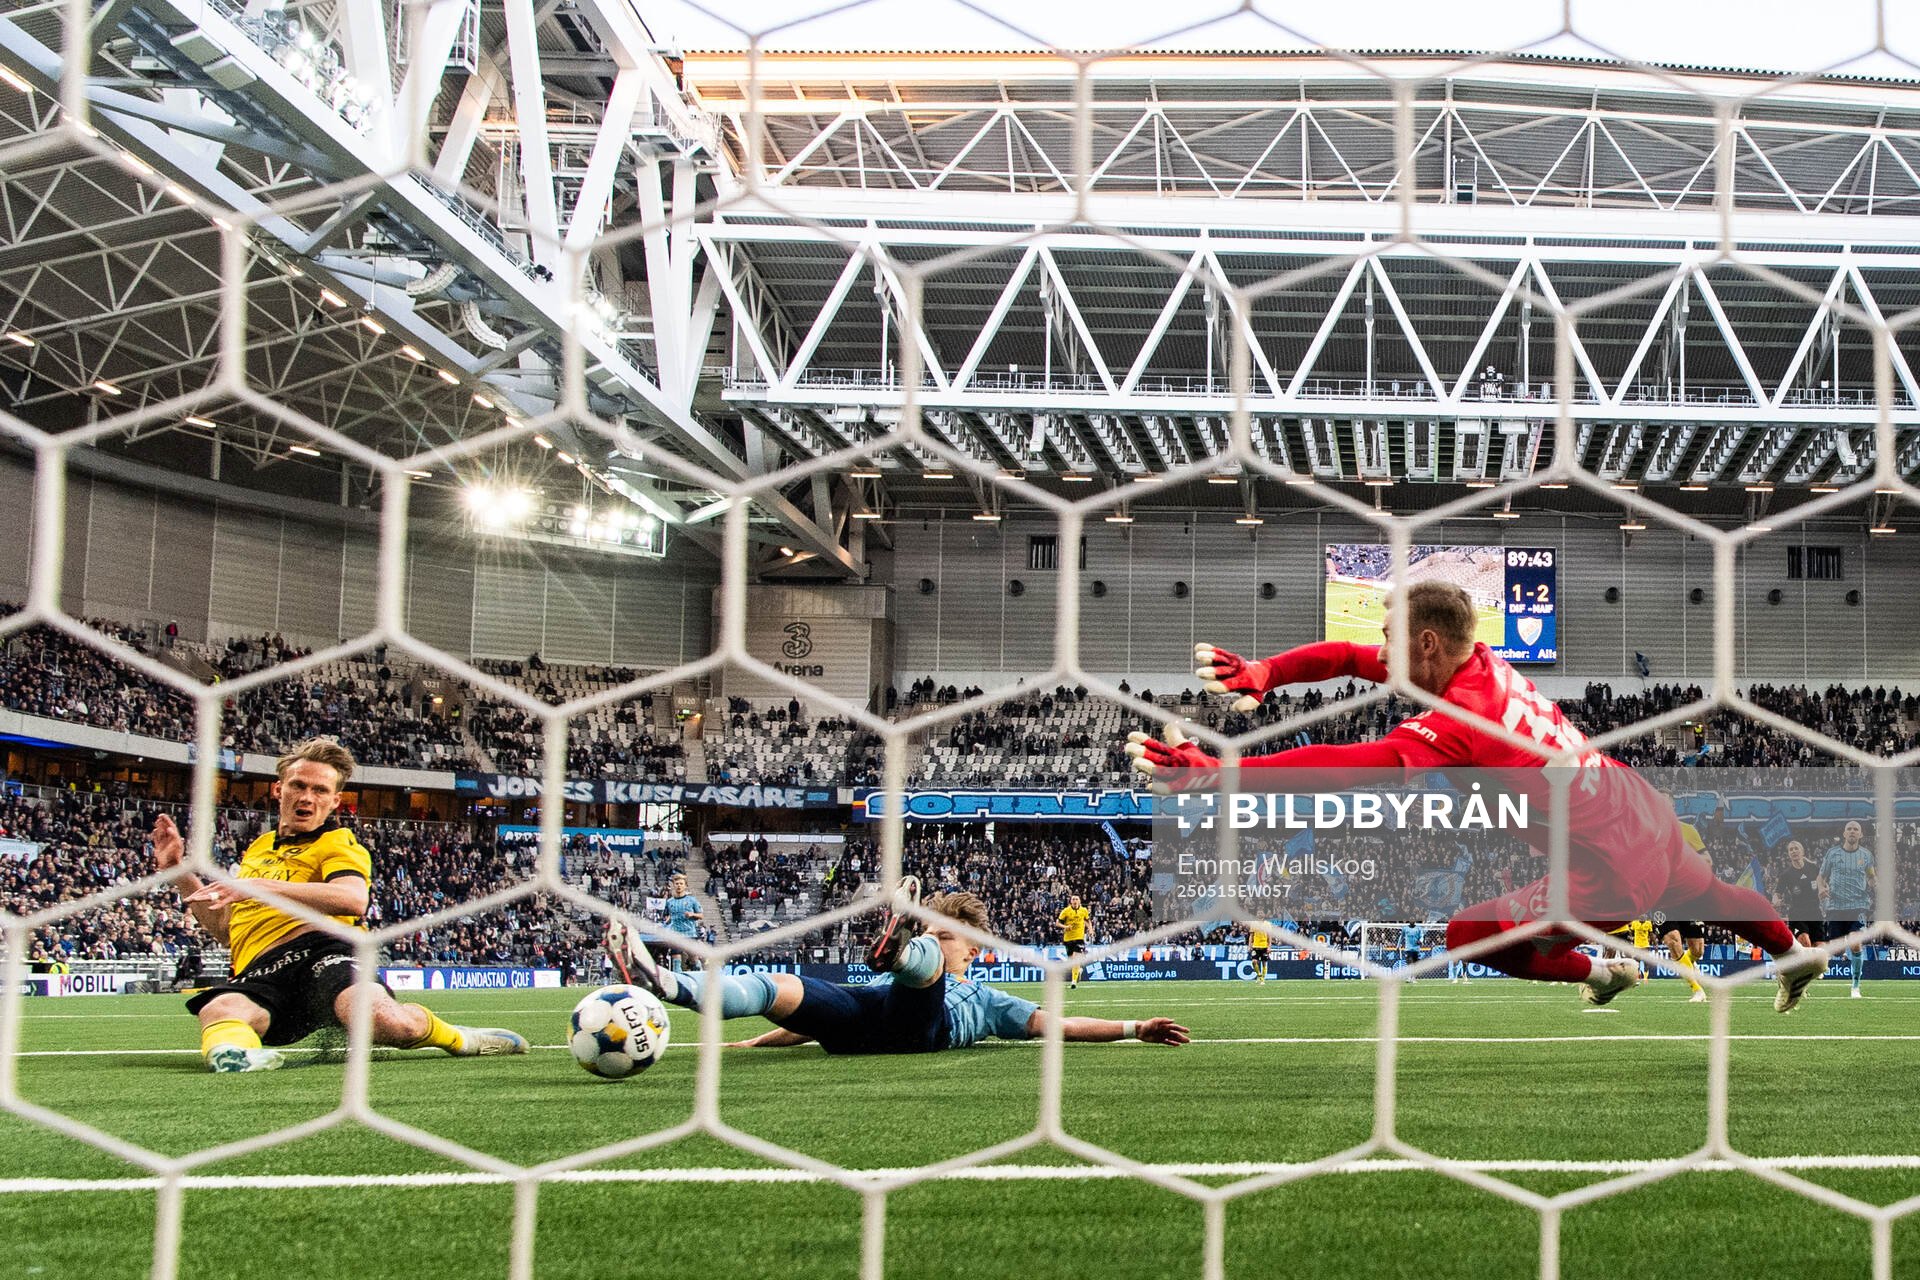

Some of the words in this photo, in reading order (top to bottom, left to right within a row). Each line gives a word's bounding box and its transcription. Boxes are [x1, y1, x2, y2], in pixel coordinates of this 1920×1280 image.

[1507, 551, 1553, 567] 89:43
[1512, 584, 1521, 602] 1
[1537, 584, 1549, 602] 2
[773, 661, 824, 677] Arena
[963, 963, 1045, 982] tadium
[1106, 963, 1145, 972] Haninge
[1107, 970, 1163, 980] Terrazzogolv
[1165, 970, 1177, 978] AB
[1215, 961, 1278, 980] TCL
[60, 975, 117, 994] MOBILL
[450, 970, 507, 989] ARLANDASTAD
[511, 970, 530, 988] GOLF
[621, 1005, 650, 1053] SELECT
